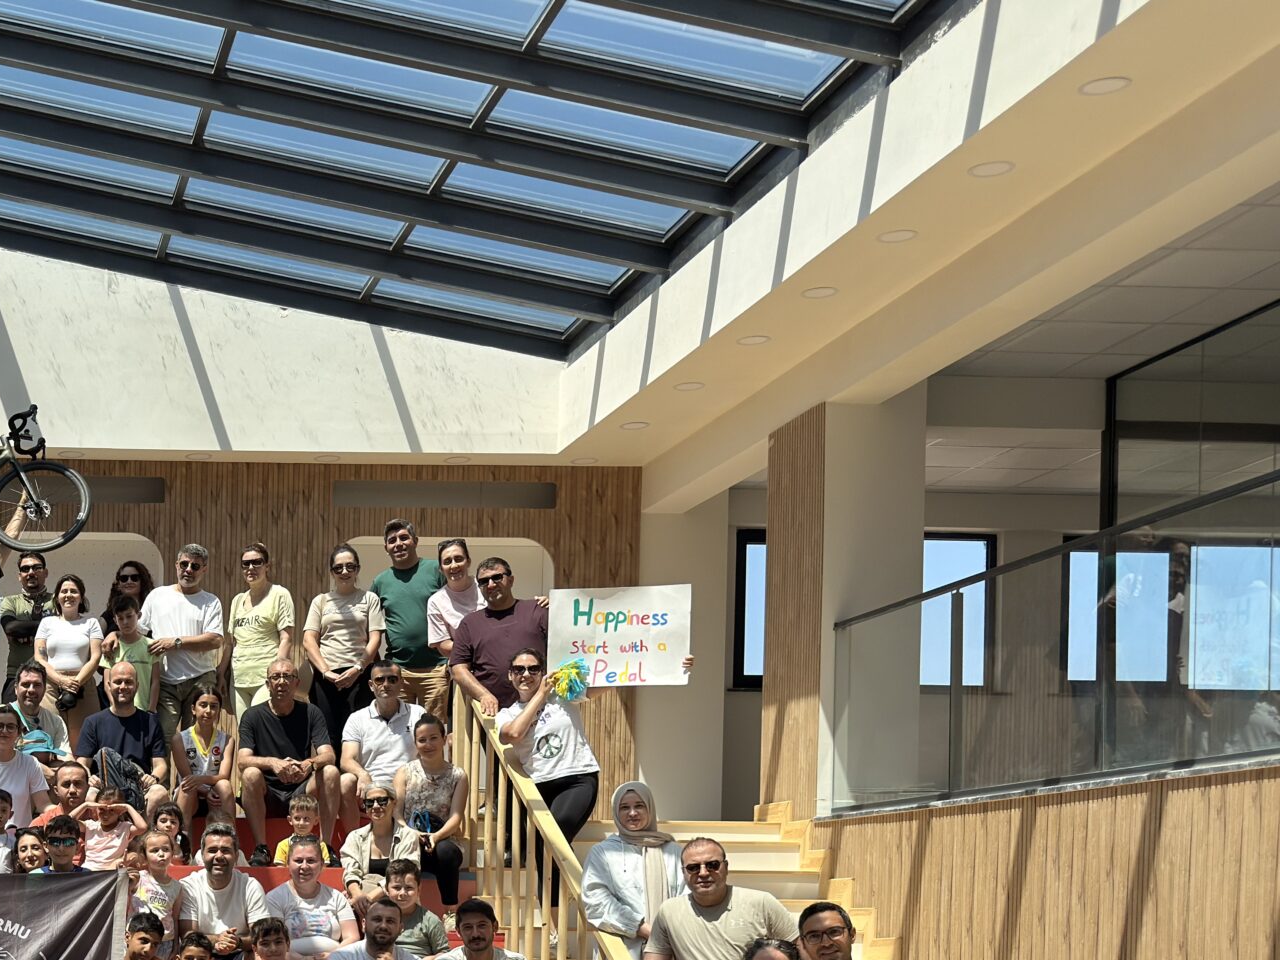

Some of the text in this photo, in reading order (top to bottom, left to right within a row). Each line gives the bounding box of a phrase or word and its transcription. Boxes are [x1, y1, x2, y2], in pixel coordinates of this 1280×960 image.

[573, 597, 669, 633] Happiness
[619, 639, 648, 654] with
[657, 642, 667, 652] a
[592, 658, 647, 686] Pedal
